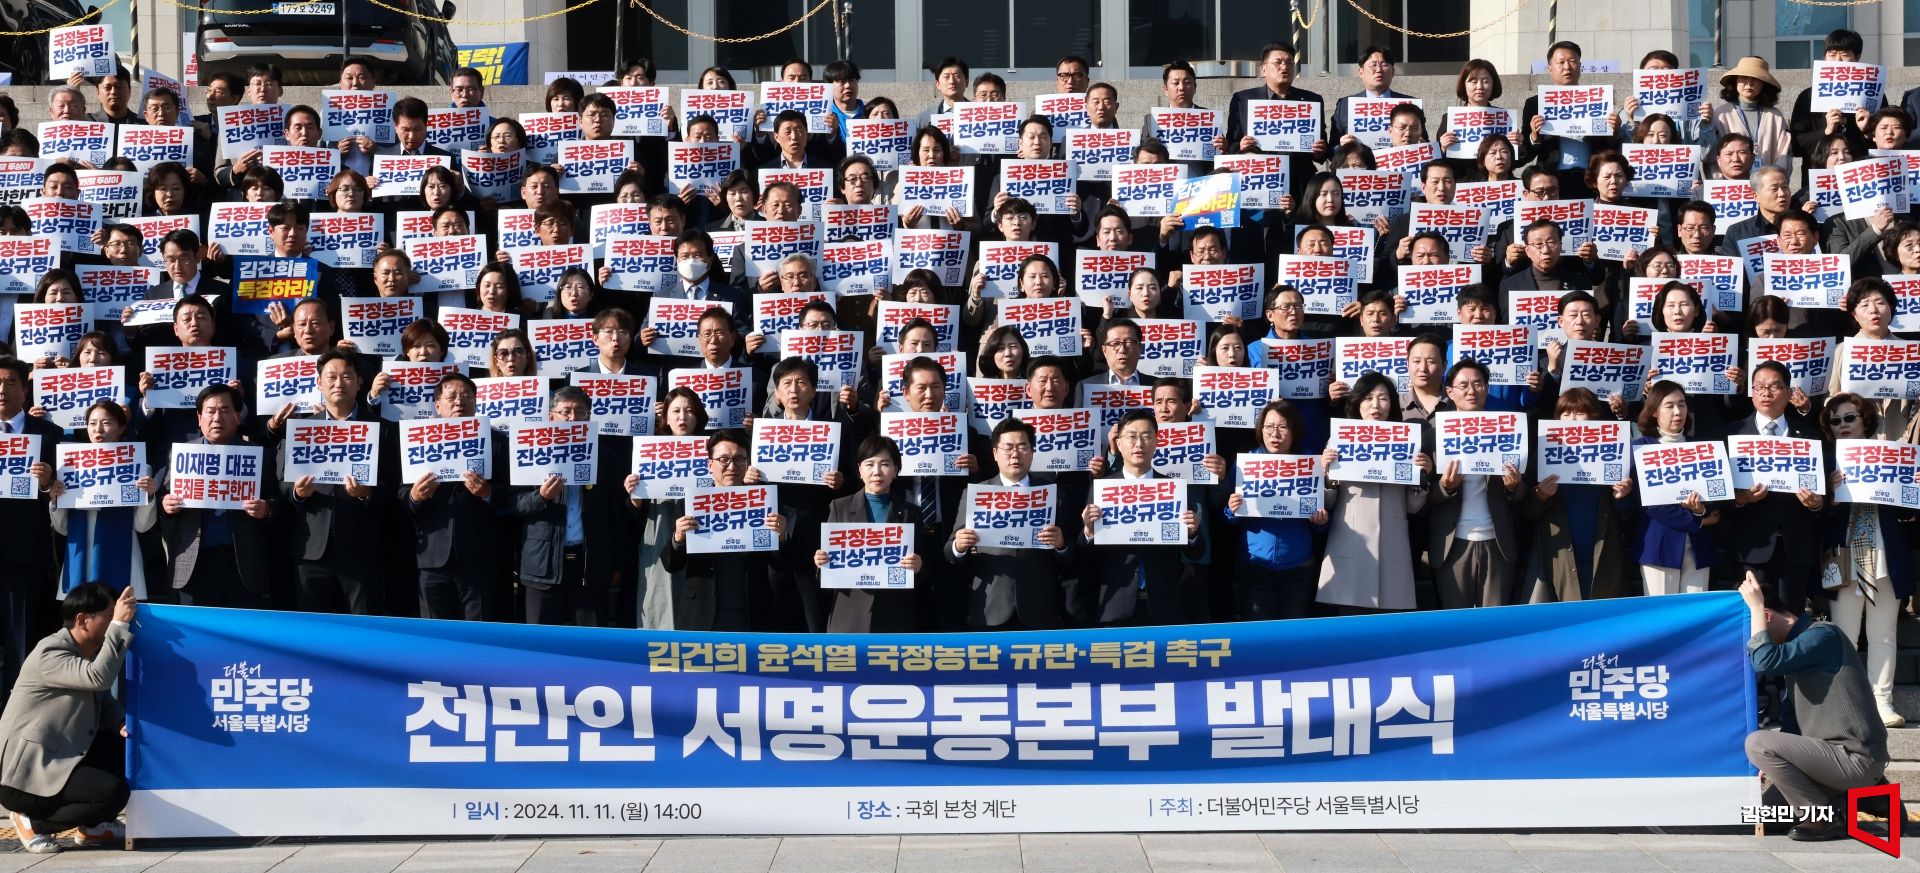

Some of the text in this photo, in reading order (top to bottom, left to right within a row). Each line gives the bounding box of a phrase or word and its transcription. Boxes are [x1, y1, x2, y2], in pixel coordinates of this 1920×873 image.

[308, 4, 333, 13] 3249
[54, 27, 105, 45] 국정농단
[53, 41, 109, 63] 진상규명!
[1639, 70, 1700, 89] 국정농단
[1819, 65, 1878, 81] 국정농단
[766, 86, 825, 101] 국정농단
[1544, 87, 1604, 104] 국정농단
[1639, 86, 1702, 105] 진상규명!
[1818, 79, 1881, 97] 진상규명!
[327, 92, 388, 109] 국정농단
[327, 107, 392, 127] 진상규명!
[958, 104, 1018, 121] 국정농단
[1157, 111, 1215, 128] 국정농단
[1254, 103, 1312, 119] 국정농단
[1544, 103, 1608, 121] 진상규명!
[44, 123, 105, 141] 국정농단
[851, 122, 908, 138] 국정농단
[1156, 127, 1218, 142] 진상규명!
[1253, 119, 1315, 135] 진상규명!
[123, 129, 184, 145] 국정농단
[852, 138, 912, 155] 진상규명!
[1072, 130, 1132, 148] 국정농단
[41, 138, 109, 158] 진상규명!
[123, 144, 188, 162] 진상규명!
[270, 149, 332, 165] 국정농단
[564, 142, 625, 160] 국정농단
[674, 143, 732, 161] 국정농단
[1629, 148, 1691, 165] 국정농단
[564, 157, 629, 178] 진상규명!
[674, 158, 737, 179] 진상규명!
[1006, 162, 1068, 180] 국정농단
[1118, 168, 1179, 184] 국정농단
[1843, 160, 1902, 184] 국정농단
[905, 169, 965, 186] 국정농단
[904, 182, 967, 199] 진상규명!
[1006, 178, 1071, 197] 진상규명!
[1845, 176, 1906, 202] 진상규명!
[28, 202, 94, 219] 국정농단
[1418, 207, 1481, 224] 국정농단
[311, 215, 375, 233] 국정농단
[751, 225, 816, 242] 국정농단
[309, 231, 380, 251] 진상규명!
[412, 237, 476, 257] 국정농단
[901, 232, 962, 249] 국정농단
[519, 246, 583, 265] 국정농단
[822, 242, 882, 262] 국정농단
[899, 248, 963, 268] 진상규명!
[240, 260, 307, 279] 김건희를
[413, 253, 482, 276] 진상규명!
[822, 259, 888, 279] 진상규명!
[1286, 261, 1349, 276] 국정농단
[1771, 257, 1839, 274] 국정농단
[1190, 266, 1256, 286] 국정농단
[1771, 274, 1845, 290] 진상규명!
[237, 280, 315, 298] 특검하라!
[1189, 283, 1259, 307] 진상규명!
[20, 306, 83, 323] 국정농단
[1005, 300, 1071, 319] 국정농단
[788, 333, 854, 353] 국정농단
[1460, 328, 1529, 345] 국정농단
[1659, 336, 1729, 354] 국정농단
[153, 350, 226, 370] 국정농단
[1574, 347, 1642, 363] 국정농단
[1756, 340, 1826, 361] 국정농단
[1570, 364, 1643, 381] 진상규명!
[1658, 353, 1732, 374] 진상규명!
[41, 369, 113, 391] 국정농단
[154, 368, 231, 390] 진상규명!
[1201, 369, 1269, 389] 국정농단
[1200, 387, 1273, 409] 진상규명!
[408, 420, 480, 441] 국정농단
[888, 415, 958, 436] 국정농단
[1339, 424, 1410, 442] 국정농단
[1444, 414, 1516, 433] 국정농단
[1546, 423, 1619, 443] 국정농단
[294, 425, 369, 442] 국정농단
[517, 424, 589, 444] 국정농단
[759, 424, 831, 443] 국정농단
[292, 443, 371, 464] 진상규명!
[408, 441, 485, 464] 진상규명!
[757, 443, 833, 463] 진상규명!
[1338, 441, 1415, 461] 진상규명!
[1443, 432, 1521, 456] 진상규명!
[1544, 442, 1623, 464] 진상규명!
[1737, 439, 1811, 458] 국정농단
[64, 445, 135, 467] 국정농단
[176, 453, 256, 476] 이재명 대표
[517, 444, 592, 466] 진상규명!
[1643, 443, 1714, 467] 국정농단
[1737, 454, 1816, 473] 진상규명!
[63, 464, 139, 489] 진상규명!
[1243, 458, 1315, 477] 국정농단
[1645, 459, 1722, 486] 진상규명!
[174, 478, 256, 501] 무죄를 촉구한다!
[1102, 481, 1175, 504] 국정농단
[1242, 476, 1319, 498] 진상규명!
[693, 487, 767, 511] 국정농단
[975, 488, 1048, 509] 국정농단
[694, 507, 772, 534] 진상규명!
[973, 507, 1051, 529] 진상규명!
[1101, 500, 1181, 527] 진상규명!
[829, 525, 903, 546] 국정농단
[828, 543, 908, 570] 진상규명!
[647, 637, 1231, 673] 김건희 윤석열 국정농단 규탄·특검 촉구
[1582, 653, 1619, 670] 더불어
[223, 661, 261, 680] 더불어
[1569, 665, 1670, 700] 민주당
[211, 678, 313, 712] 민주당
[406, 675, 1454, 763] 천만인 서명운동본부 발대식
[1569, 701, 1669, 720] 서울특별시당
[212, 714, 310, 733] 서울특별시당
[465, 801, 702, 822] 일시 2024. 11. 11. (월) 14:00
[857, 800, 1017, 820] 장소 국회 본청 계단
[1159, 795, 1419, 817] 주최 더불어민주당 서울특별시당
